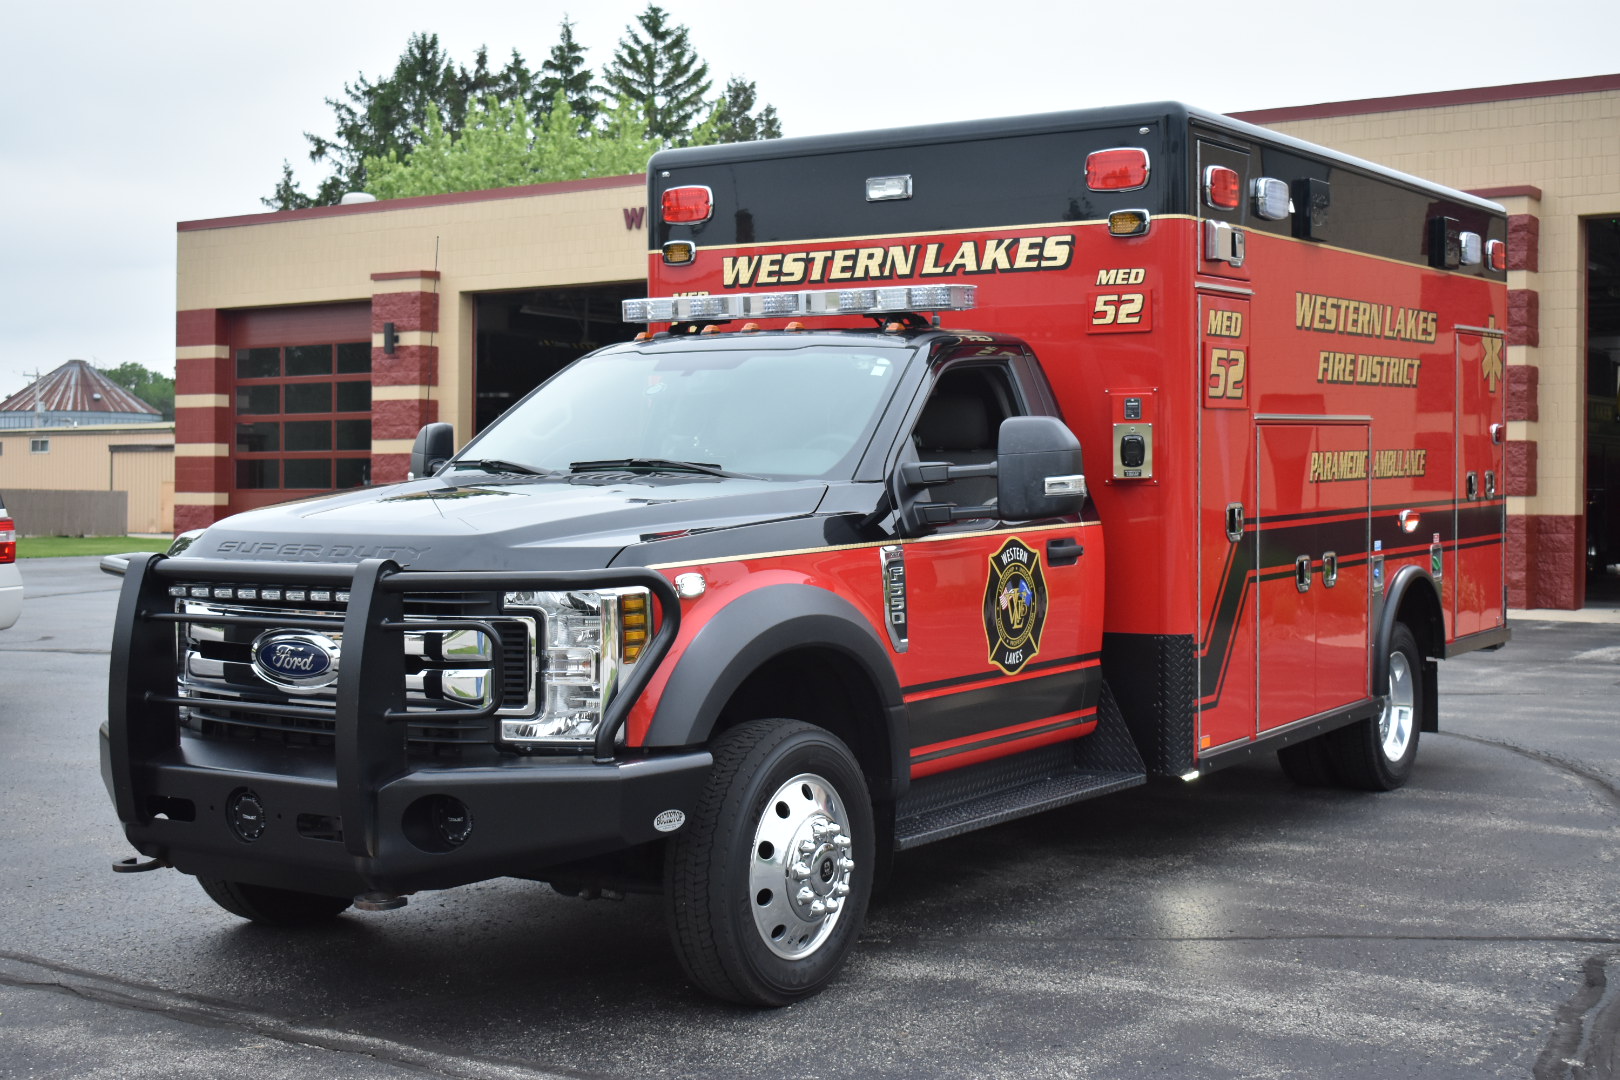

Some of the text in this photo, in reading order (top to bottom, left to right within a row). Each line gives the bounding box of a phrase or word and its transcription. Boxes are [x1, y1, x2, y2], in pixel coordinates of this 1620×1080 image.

[722, 234, 1076, 288] WESTERN LAKES
[1096, 268, 1146, 286] MED
[1092, 293, 1144, 325] 52
[1207, 309, 1242, 338] MED
[1295, 291, 1437, 344] WESTERN LAKES
[1208, 348, 1245, 399] 52
[1317, 350, 1421, 388] FIRE DISTRICT
[1310, 448, 1427, 483] PARAMEDIC AMBULANCE
[216, 541, 432, 561] SUPER DUTY
[1001, 547, 1028, 566] WESTERN
[272, 644, 315, 671] Ford
[1004, 649, 1023, 665] LAKES
